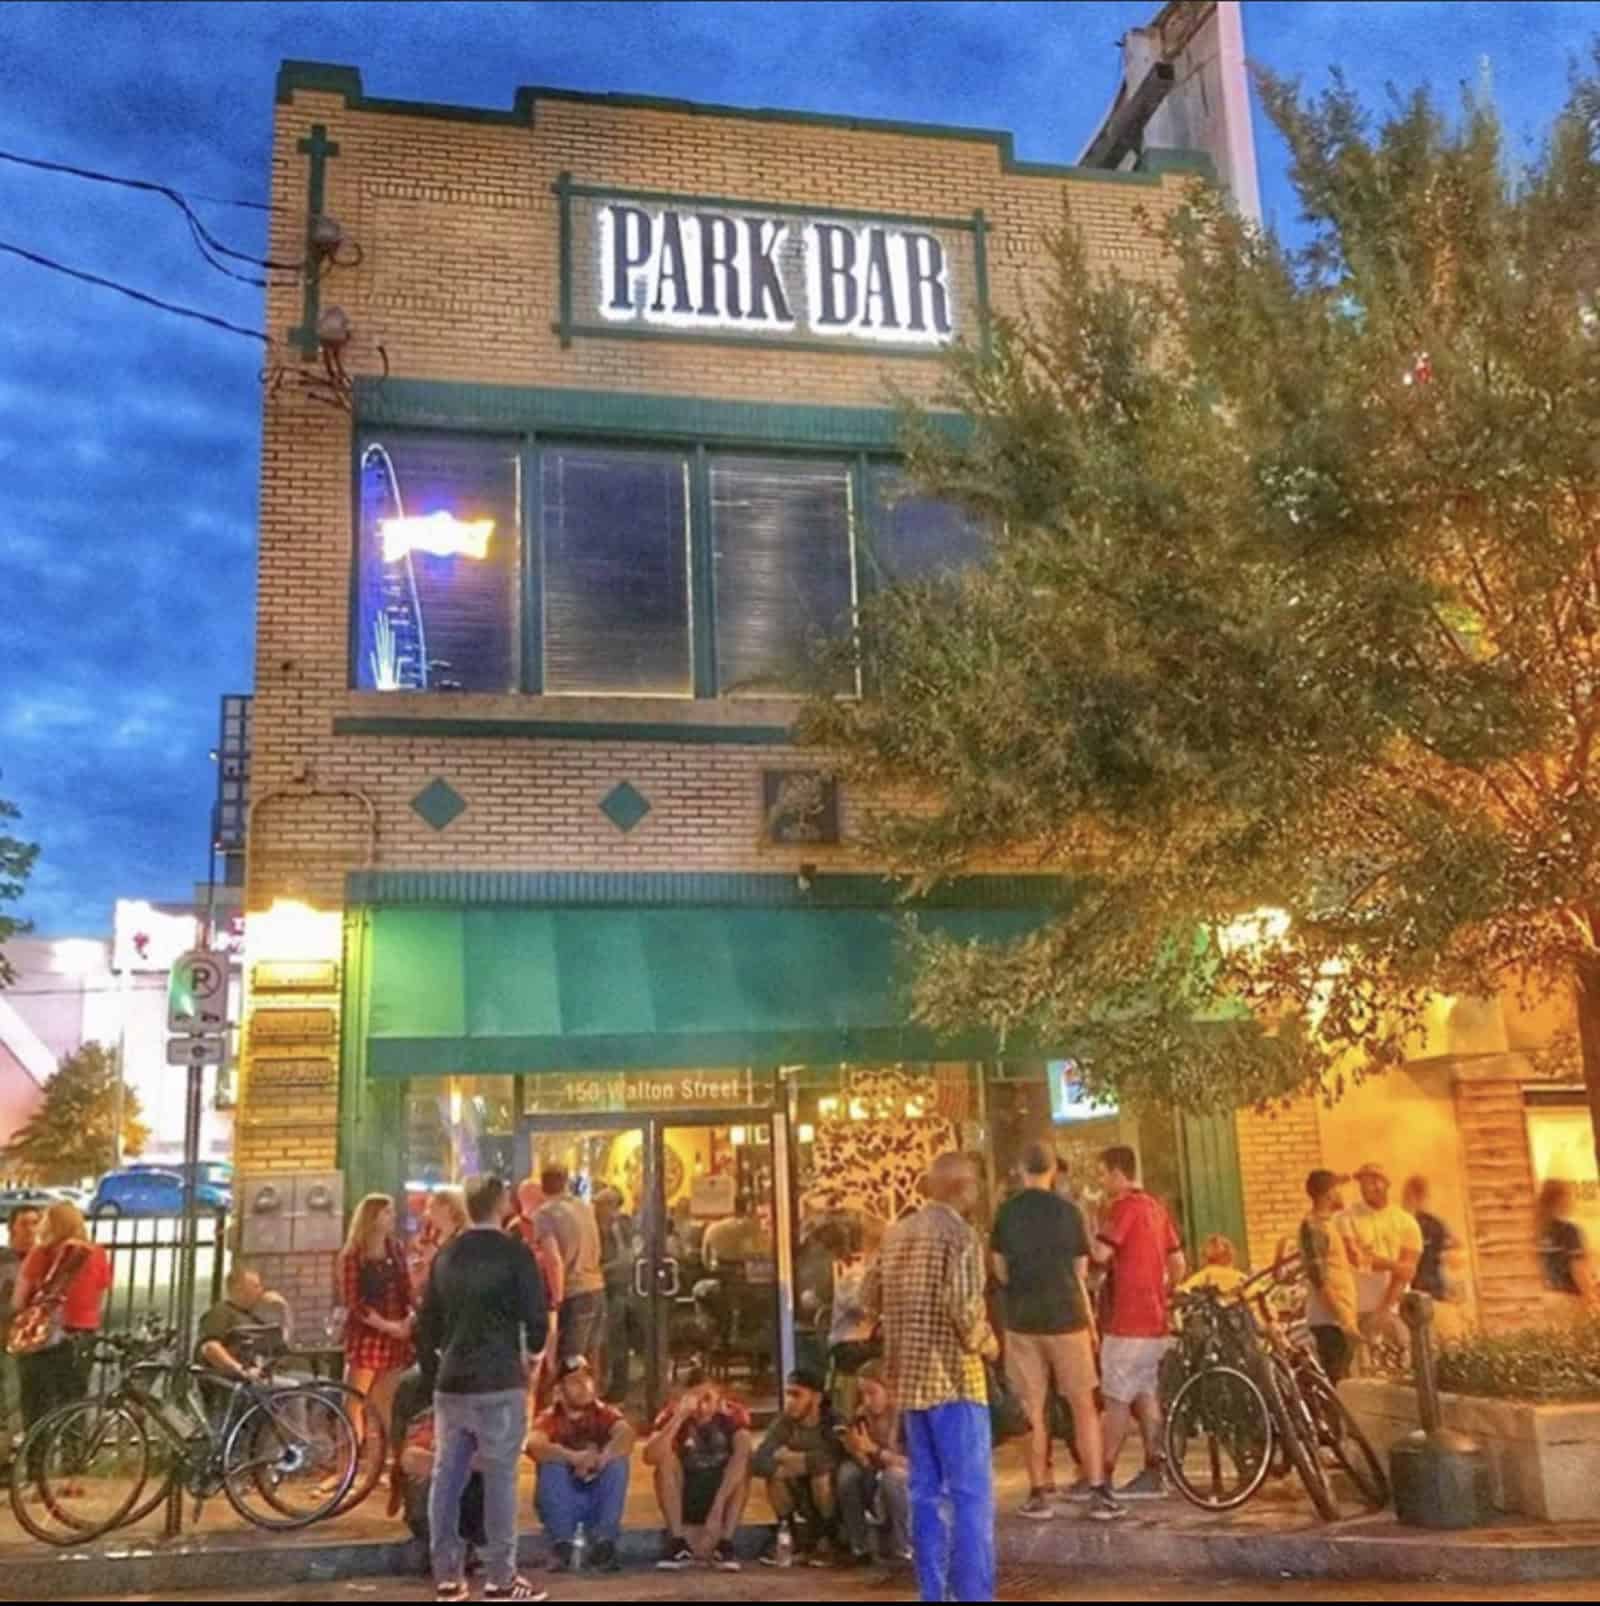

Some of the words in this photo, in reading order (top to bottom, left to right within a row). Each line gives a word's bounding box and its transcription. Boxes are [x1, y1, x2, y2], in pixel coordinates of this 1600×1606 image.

[607, 204, 795, 322] PARK
[812, 222, 952, 334] BAR
[564, 1079, 599, 1103] 150
[607, 1078, 675, 1101] Walton
[680, 1077, 739, 1099] Street
